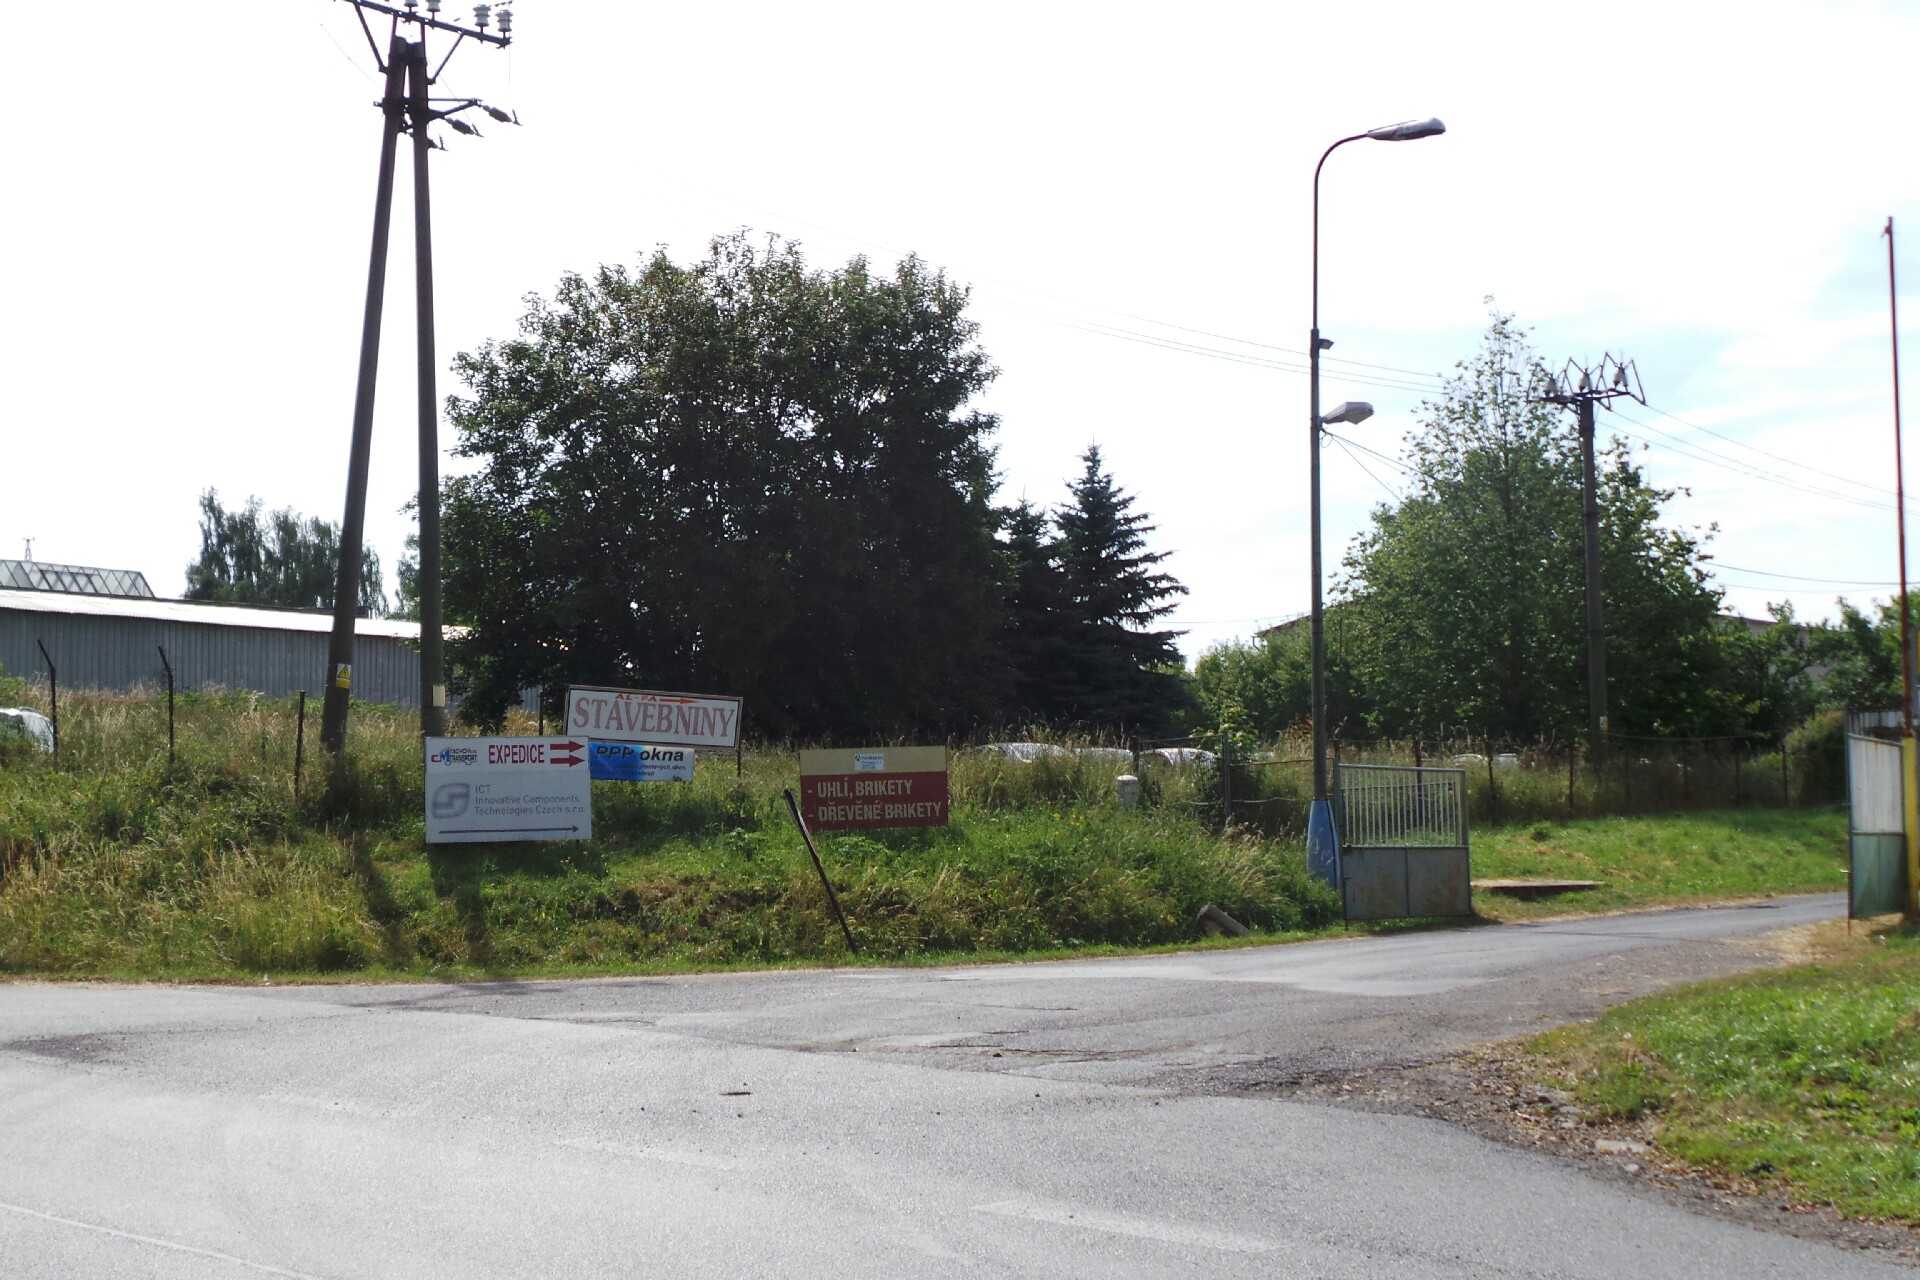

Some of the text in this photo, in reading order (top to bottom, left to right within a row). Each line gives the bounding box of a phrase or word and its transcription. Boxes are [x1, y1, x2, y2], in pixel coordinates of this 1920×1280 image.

[572, 696, 735, 738] STAVEBNINY
[488, 744, 545, 765] EXPEDICE
[595, 745, 684, 761] PPP okna
[475, 784, 491, 794] ICT
[855, 779, 913, 797] BRIKETY
[475, 794, 580, 806] Innovative Components
[474, 806, 534, 817] Technologies
[535, 805, 563, 815] Czech
[818, 800, 942, 822] DŘEVĚNÉ BRIKETY
